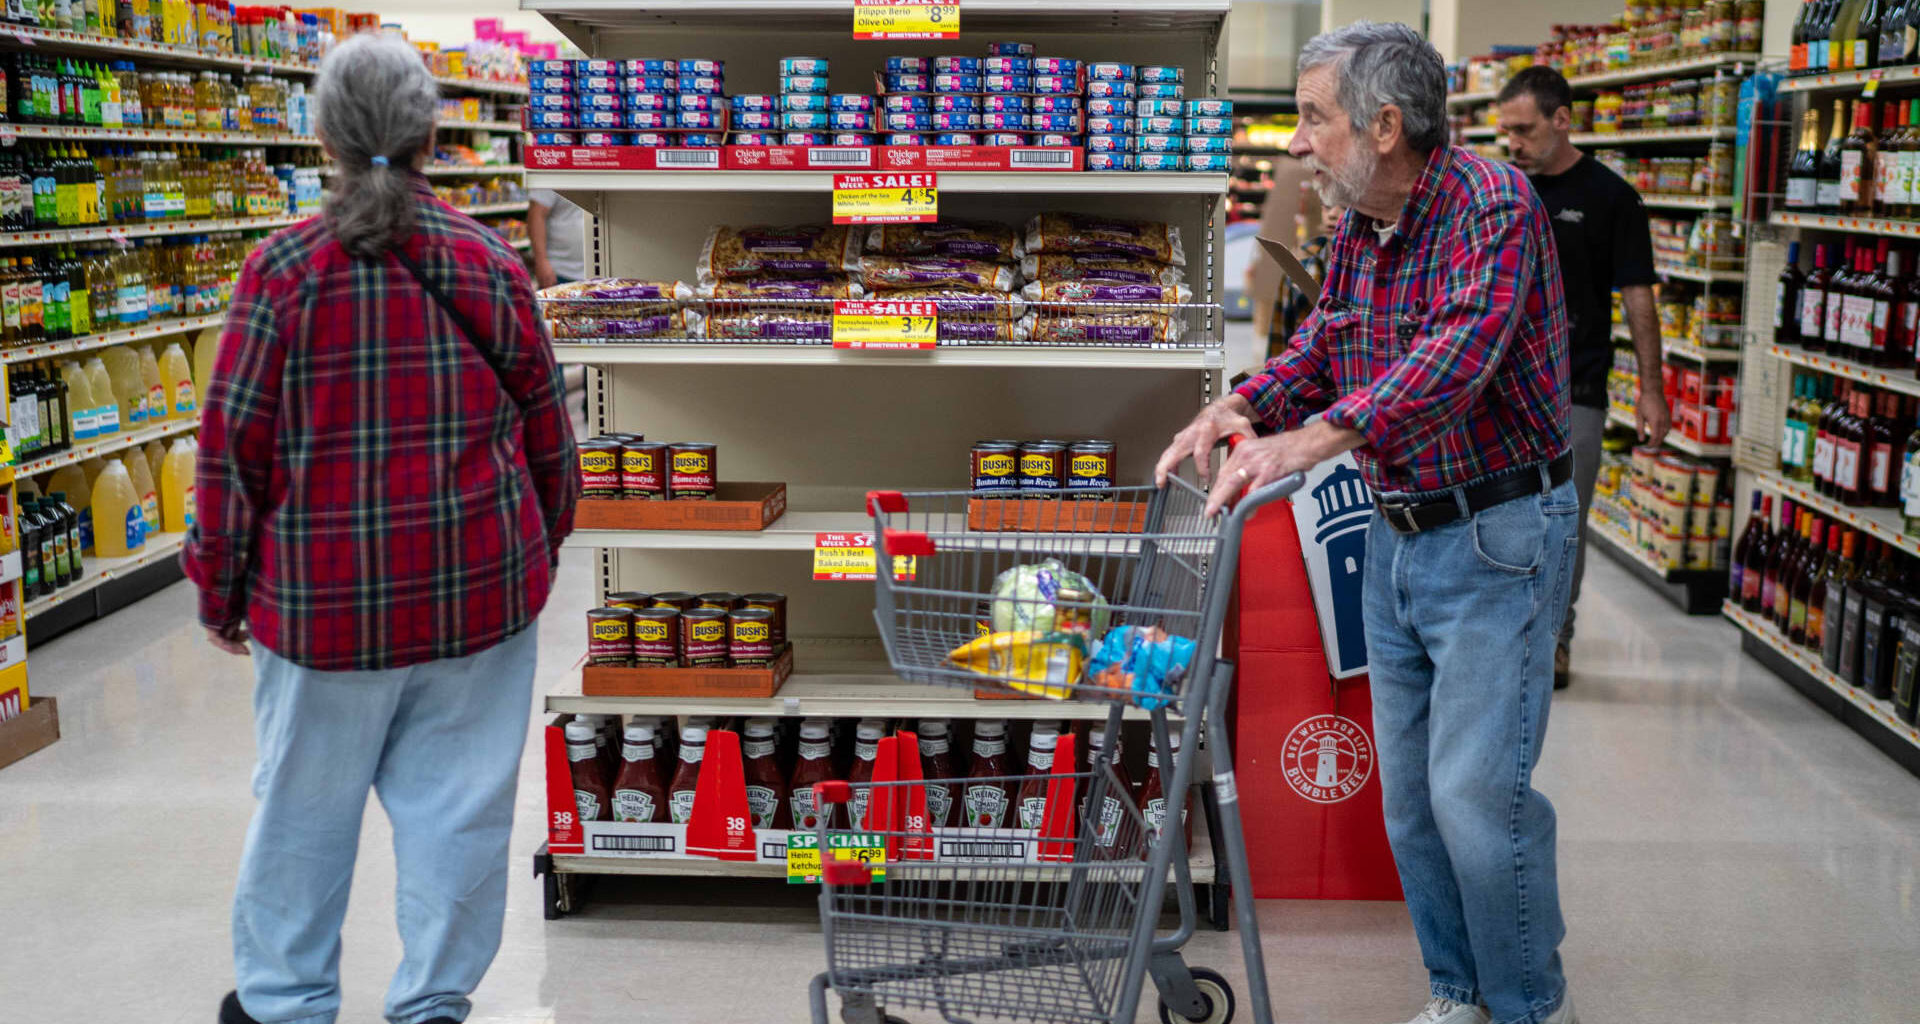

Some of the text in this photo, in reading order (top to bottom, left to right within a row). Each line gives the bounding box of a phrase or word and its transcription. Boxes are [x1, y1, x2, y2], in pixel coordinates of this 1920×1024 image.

[858, 18, 895, 26] Olive Oil
[534, 149, 566, 158] Chicken
[735, 149, 766, 158] Chicken
[888, 150, 920, 159] Chicken
[873, 175, 932, 188] SALE!
[901, 188, 914, 206] 4
[873, 302, 932, 315] SALE!
[901, 317, 912, 333] 3
[583, 455, 614, 468] BUSH'S
[675, 456, 706, 468] BUSH'S
[982, 459, 1013, 471] BUSH'S
[1074, 460, 1105, 471] BUSH'S
[595, 624, 626, 635] BUSH'S
[695, 624, 725, 636] BUSH'S
[736, 625, 767, 636] BUSH'S
[1287, 720, 1368, 760] BEE WELL FOR LIFE
[1287, 767, 1364, 799] BUMBLE BEE
[621, 794, 645, 804] HEINZ
[799, 792, 813, 800] HEI
[975, 791, 999, 800] HEINZ
[1030, 803, 1043, 811] HEI
[553, 811, 573, 824] 38
[906, 815, 923, 829] 38
[726, 817, 745, 831] 38
[791, 835, 881, 848] SPCIAL!
